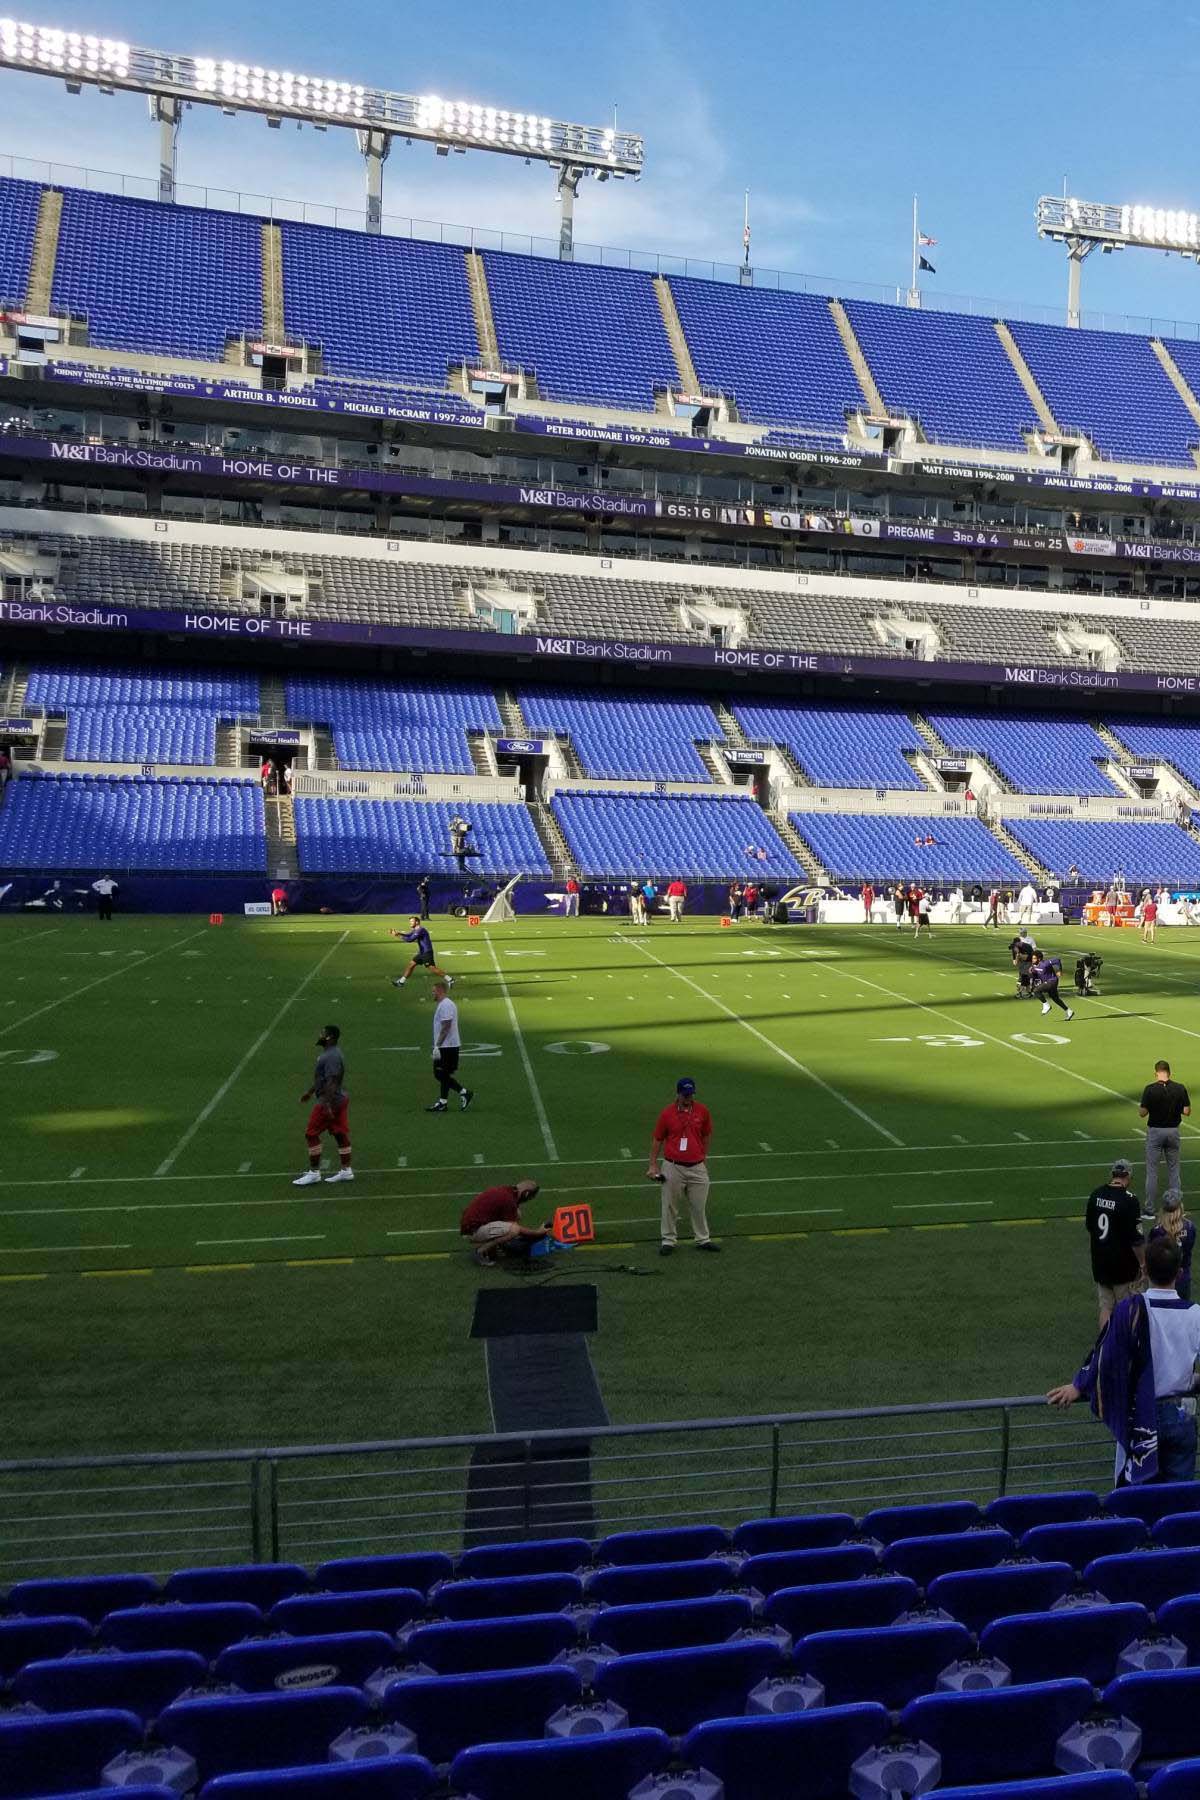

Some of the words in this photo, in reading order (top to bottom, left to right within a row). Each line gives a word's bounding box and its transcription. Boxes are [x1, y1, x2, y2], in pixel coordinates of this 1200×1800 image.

[54, 368, 82, 378] JOHNNY
[84, 372, 110, 380] UNITAS
[117, 375, 132, 383] THE
[133, 377, 173, 388] BALTIMORE
[174, 381, 196, 390] COLTS
[224, 389, 264, 402] ARTHUR
[267, 393, 276, 402] B.
[279, 394, 318, 407] MODELL
[343, 402, 385, 415] MICHAEL
[388, 407, 431, 420] McCRARY
[434, 412, 482, 425] 1997-2002
[546, 425, 574, 436] PETER
[575, 428, 622, 441] BOULWARE
[625, 433, 670, 446] 1997-2005
[51, 443, 94, 460] M&T
[95, 447, 134, 464] Bank
[136, 451, 201, 472] Stadium
[744, 446, 788, 460] JONATHAN
[789, 451, 817, 462] OGDEN
[820, 454, 862, 466] 1996-2007
[222, 460, 272, 477] HOME
[278, 465, 300, 479] OF
[306, 468, 338, 483] THE
[922, 465, 943, 476] MATT
[944, 468, 973, 478] STOVER
[975, 470, 1015, 482] 1996-2008
[1044, 477, 1069, 487] JAMAL
[1070, 479, 1093, 490] LEWIS
[1094, 482, 1132, 493] 2000-2006
[1162, 488, 1175, 496] RAY
[1177, 489, 1197, 499] LEWIS
[519, 488, 557, 505] M&T
[557, 492, 590, 508] Bank
[592, 496, 646, 515] Stadium
[667, 504, 711, 519] 65:16
[887, 525, 934, 540] PREGAME
[952, 531, 973, 544] 3RD
[976, 531, 986, 544] &
[990, 533, 999, 545] 4
[1013, 538, 1031, 548] BALL
[1048, 539, 1062, 550] 25
[1125, 543, 1153, 558] M&T
[1153, 546, 1181, 560] Bank
[10, 604, 53, 622] Bank
[56, 607, 128, 627] Stadium
[186, 615, 239, 632] HOME
[246, 619, 271, 633] OF
[277, 620, 312, 636] THE
[536, 638, 575, 654] M&T
[576, 640, 613, 657] Bank
[614, 644, 671, 661] Stadium
[715, 652, 759, 665] HOME
[764, 654, 784, 667] OF
[789, 655, 817, 669] THE
[1005, 668, 1037, 682] M&T
[1038, 669, 1068, 684] Bank
[1070, 672, 1118, 687] Stadium
[1157, 677, 1195, 689] HOME
[511, 742, 532, 750] Ford
[738, 752, 764, 760] merritt
[942, 760, 966, 768] merritt
[1096, 1198, 1115, 1210] TUCKER
[560, 1210, 590, 1238] 20
[1098, 1213, 1109, 1239] 9
